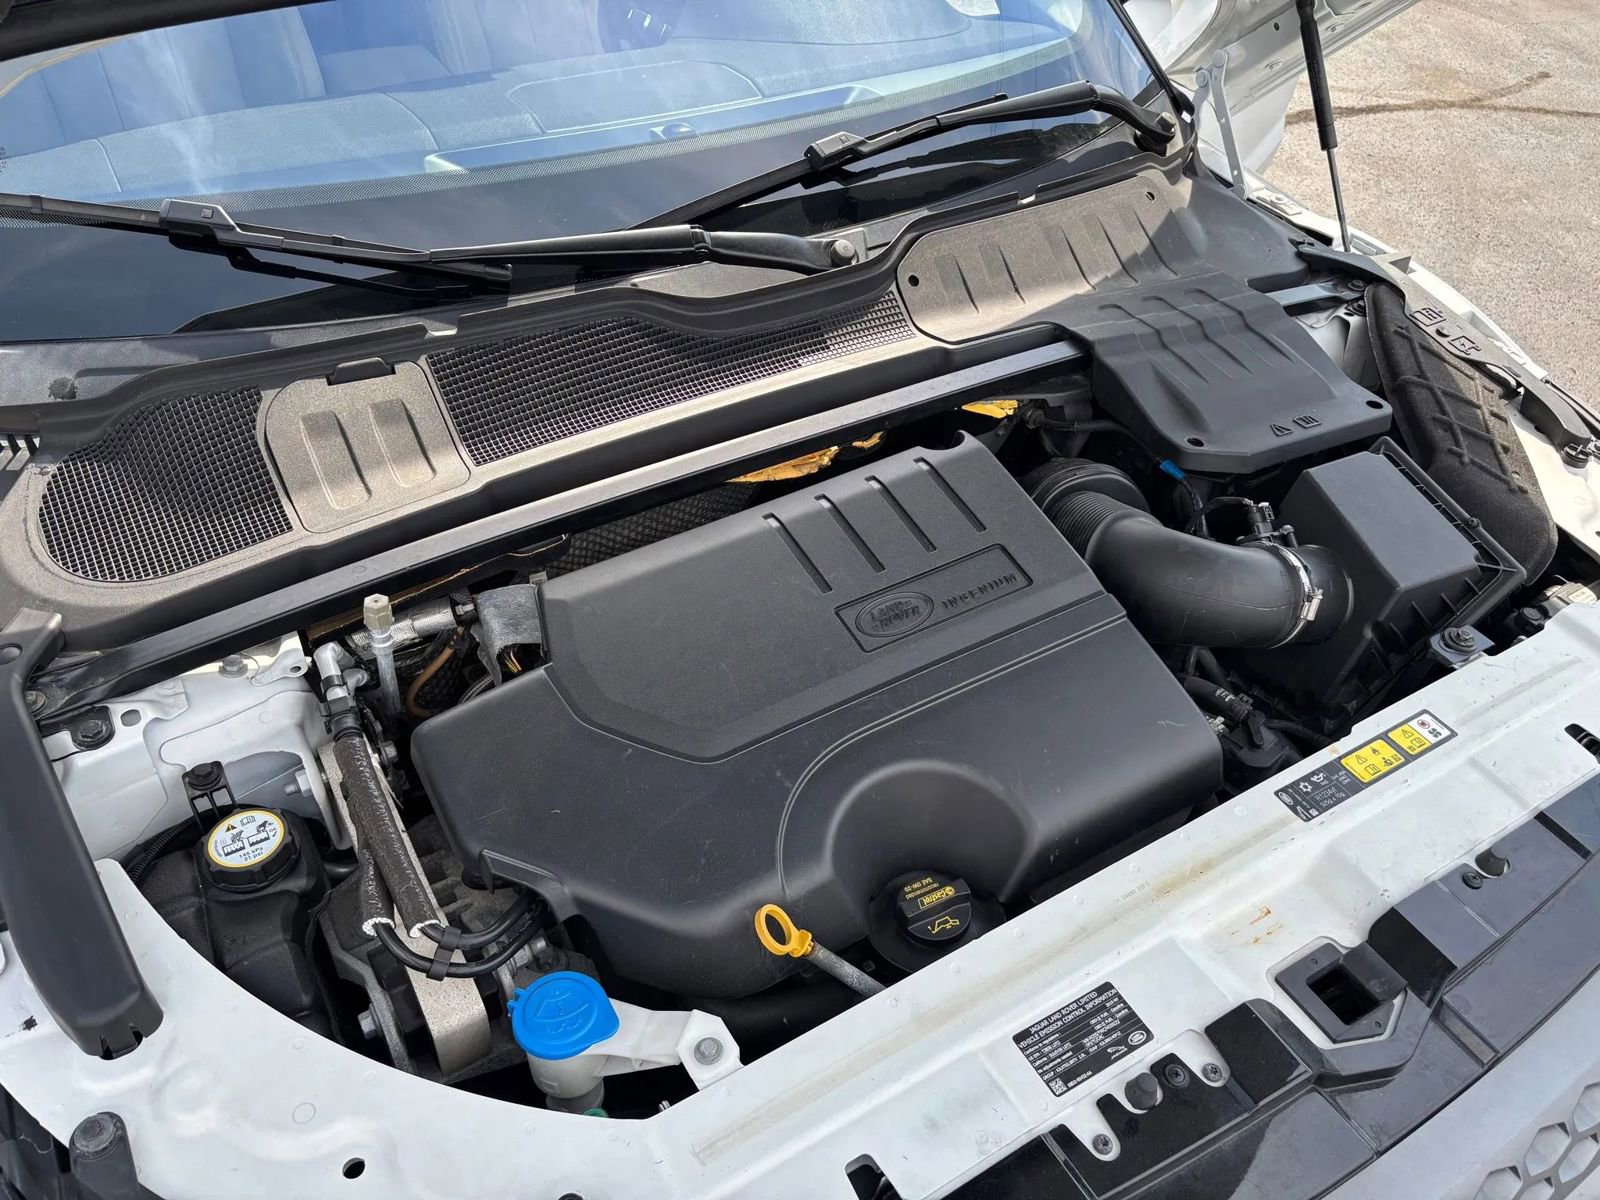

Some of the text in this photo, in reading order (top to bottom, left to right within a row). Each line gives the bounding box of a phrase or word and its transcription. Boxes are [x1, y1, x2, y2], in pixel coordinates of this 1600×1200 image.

[941, 572, 1017, 609] INGENIUM
[878, 605, 920, 631] ROVER
[923, 890, 946, 905] Castrol
[1018, 1034, 1040, 1049] VEHICLE
[1038, 1020, 1064, 1037] EMISSION
[1062, 1007, 1086, 1023] CONTROL
[1084, 988, 1118, 1010] INFORMATION
[1029, 991, 1099, 1034] JAGUAR LAND ROVER LIMITED
